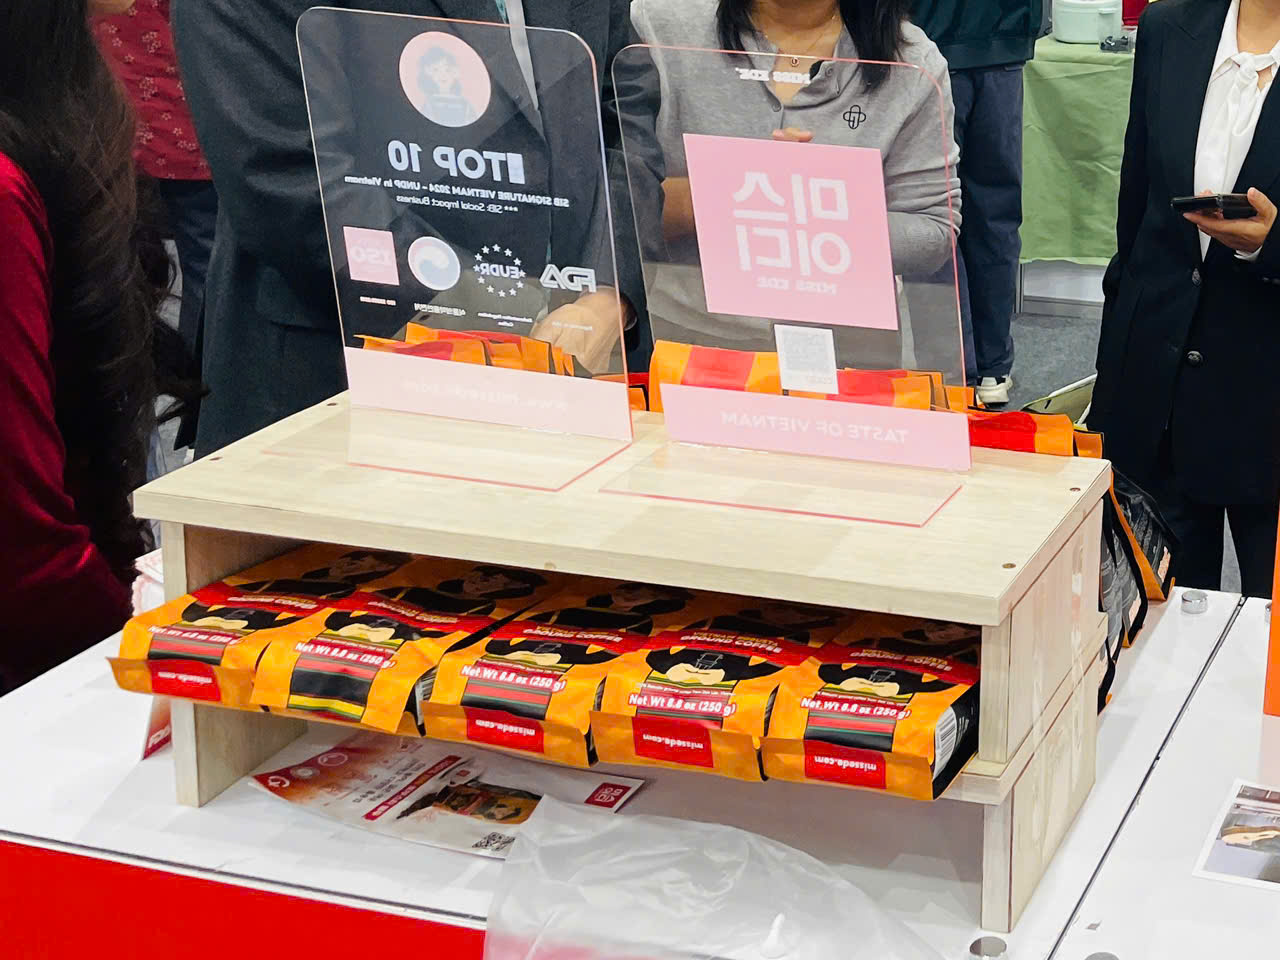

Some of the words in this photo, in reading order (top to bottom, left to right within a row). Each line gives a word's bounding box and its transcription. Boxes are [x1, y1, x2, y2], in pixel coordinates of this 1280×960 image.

[296, 642, 314, 653] Net
[315, 644, 330, 655] Wt
[680, 635, 733, 645] GROUND
[734, 640, 783, 654] COFFEE
[461, 665, 481, 677] Net
[482, 669, 497, 680] Wt
[629, 693, 648, 706] Net
[650, 695, 666, 707] Wt
[667, 698, 683, 709] 8.8
[684, 702, 696, 710] oz
[698, 700, 721, 713] (250
[723, 703, 737, 717] g)
[801, 696, 820, 709] Net
[822, 700, 839, 711] Wt
[859, 705, 872, 715] oz
[897, 708, 912, 720] g)
[643, 733, 704, 750] missede.com
[814, 755, 878, 772] missede.com
